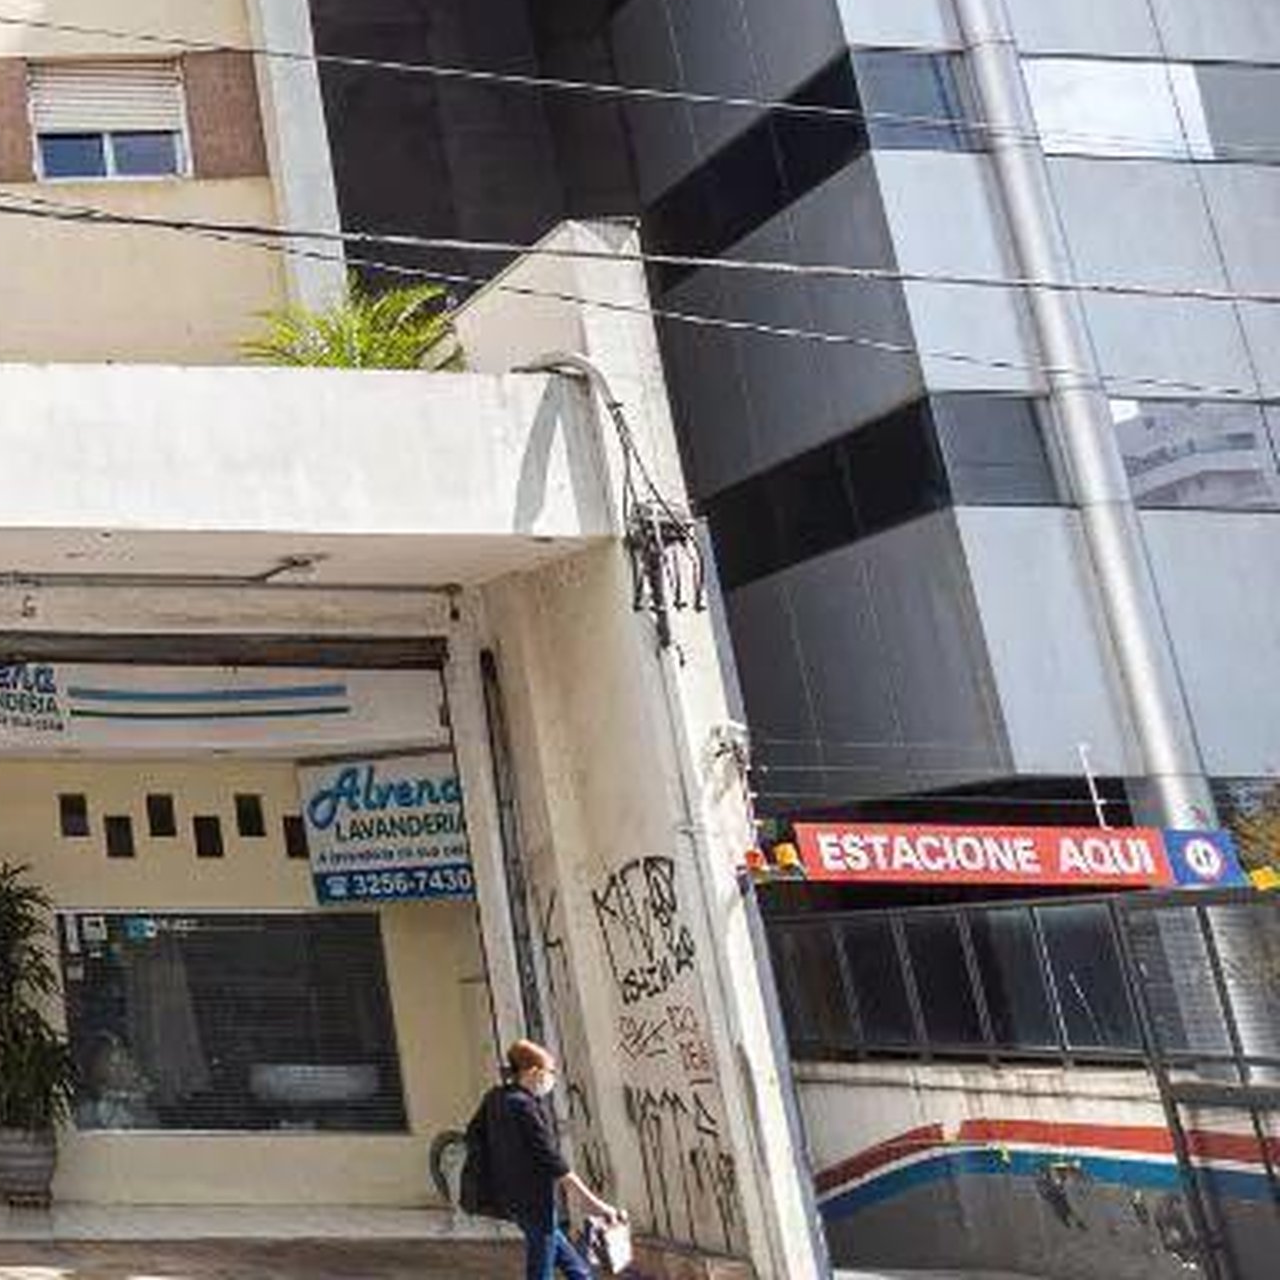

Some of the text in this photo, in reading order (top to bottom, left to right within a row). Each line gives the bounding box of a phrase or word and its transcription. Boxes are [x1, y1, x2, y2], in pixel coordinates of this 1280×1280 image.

[817, 833, 1040, 873] ESTACIONE
[1058, 836, 1156, 874] AQUI
[352, 868, 471, 896] 3256-7430
